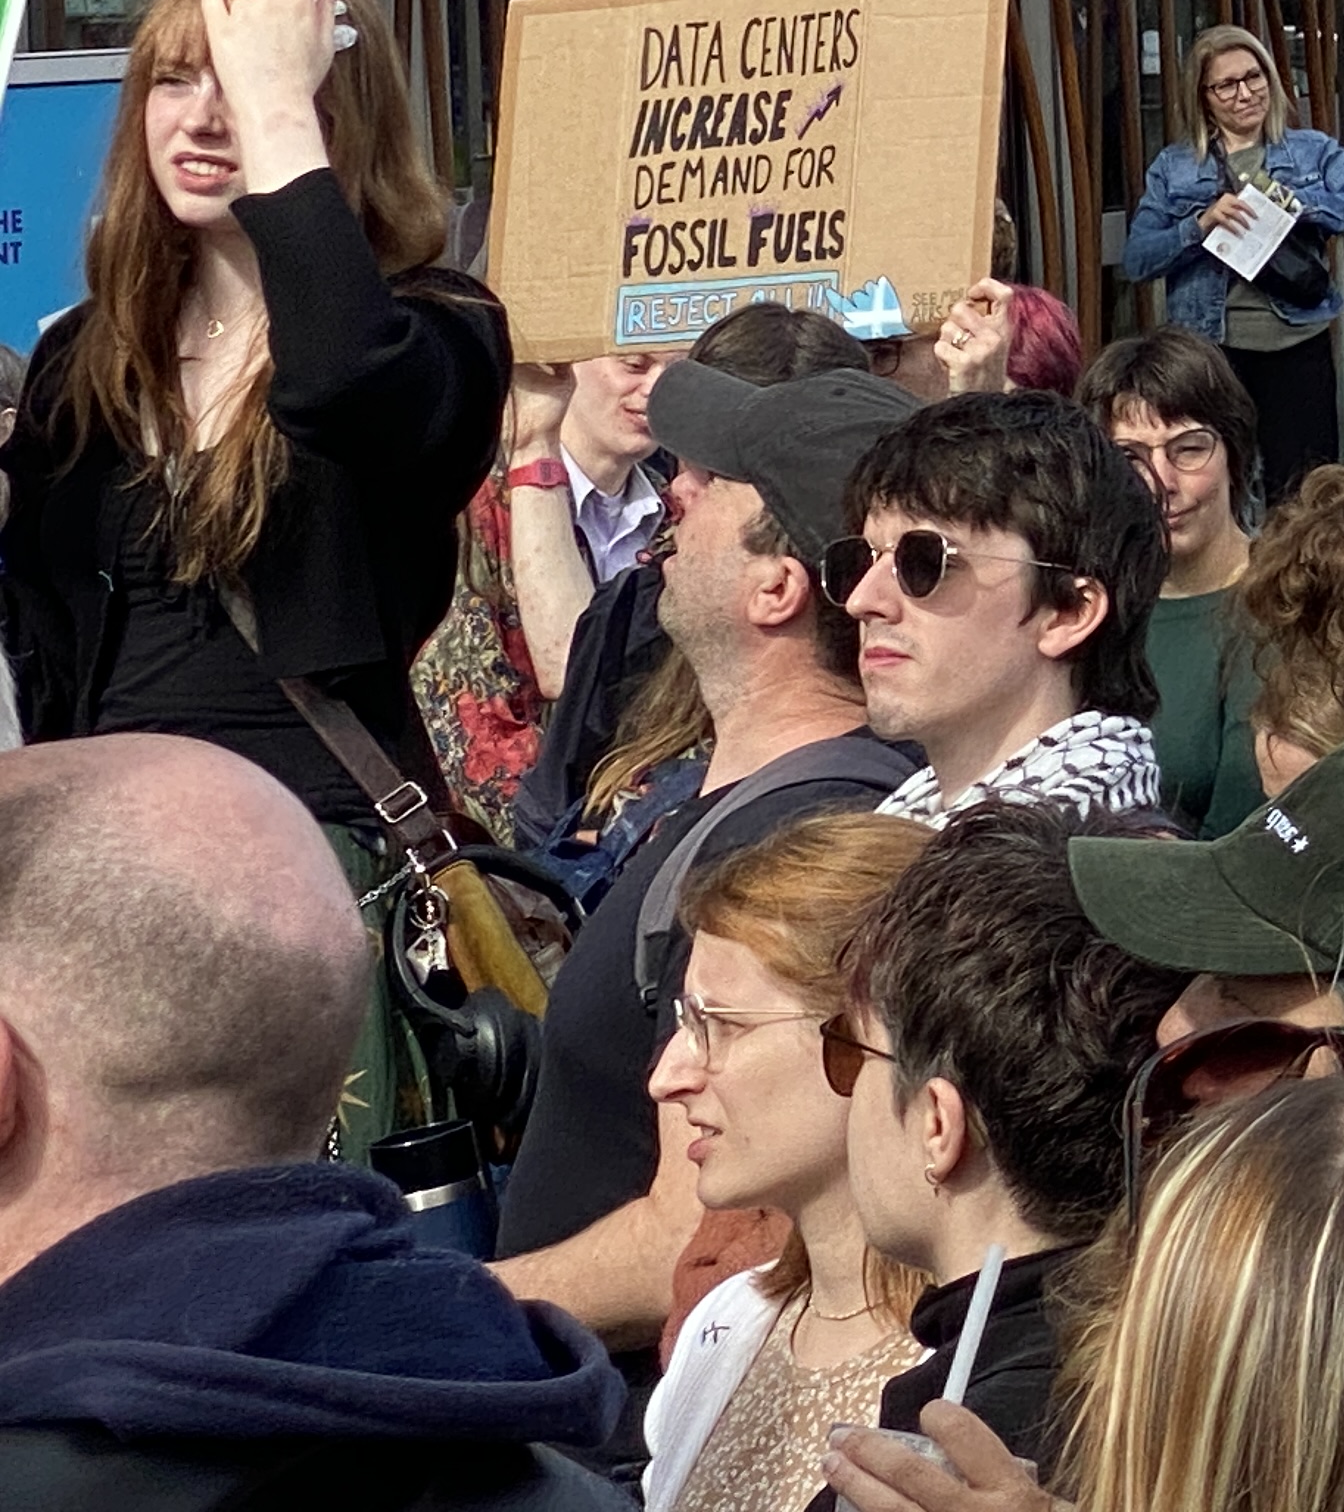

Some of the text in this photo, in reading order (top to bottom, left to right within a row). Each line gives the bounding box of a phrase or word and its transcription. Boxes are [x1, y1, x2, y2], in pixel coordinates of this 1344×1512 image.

[640, 8, 861, 91] DATA CENTERS
[629, 90, 793, 159] INCREASE
[633, 145, 836, 210] DEMAND FOR
[622, 209, 846, 278] FOSSIL FUELS
[626, 291, 737, 333] REJECT
[911, 291, 938, 307] SEE
